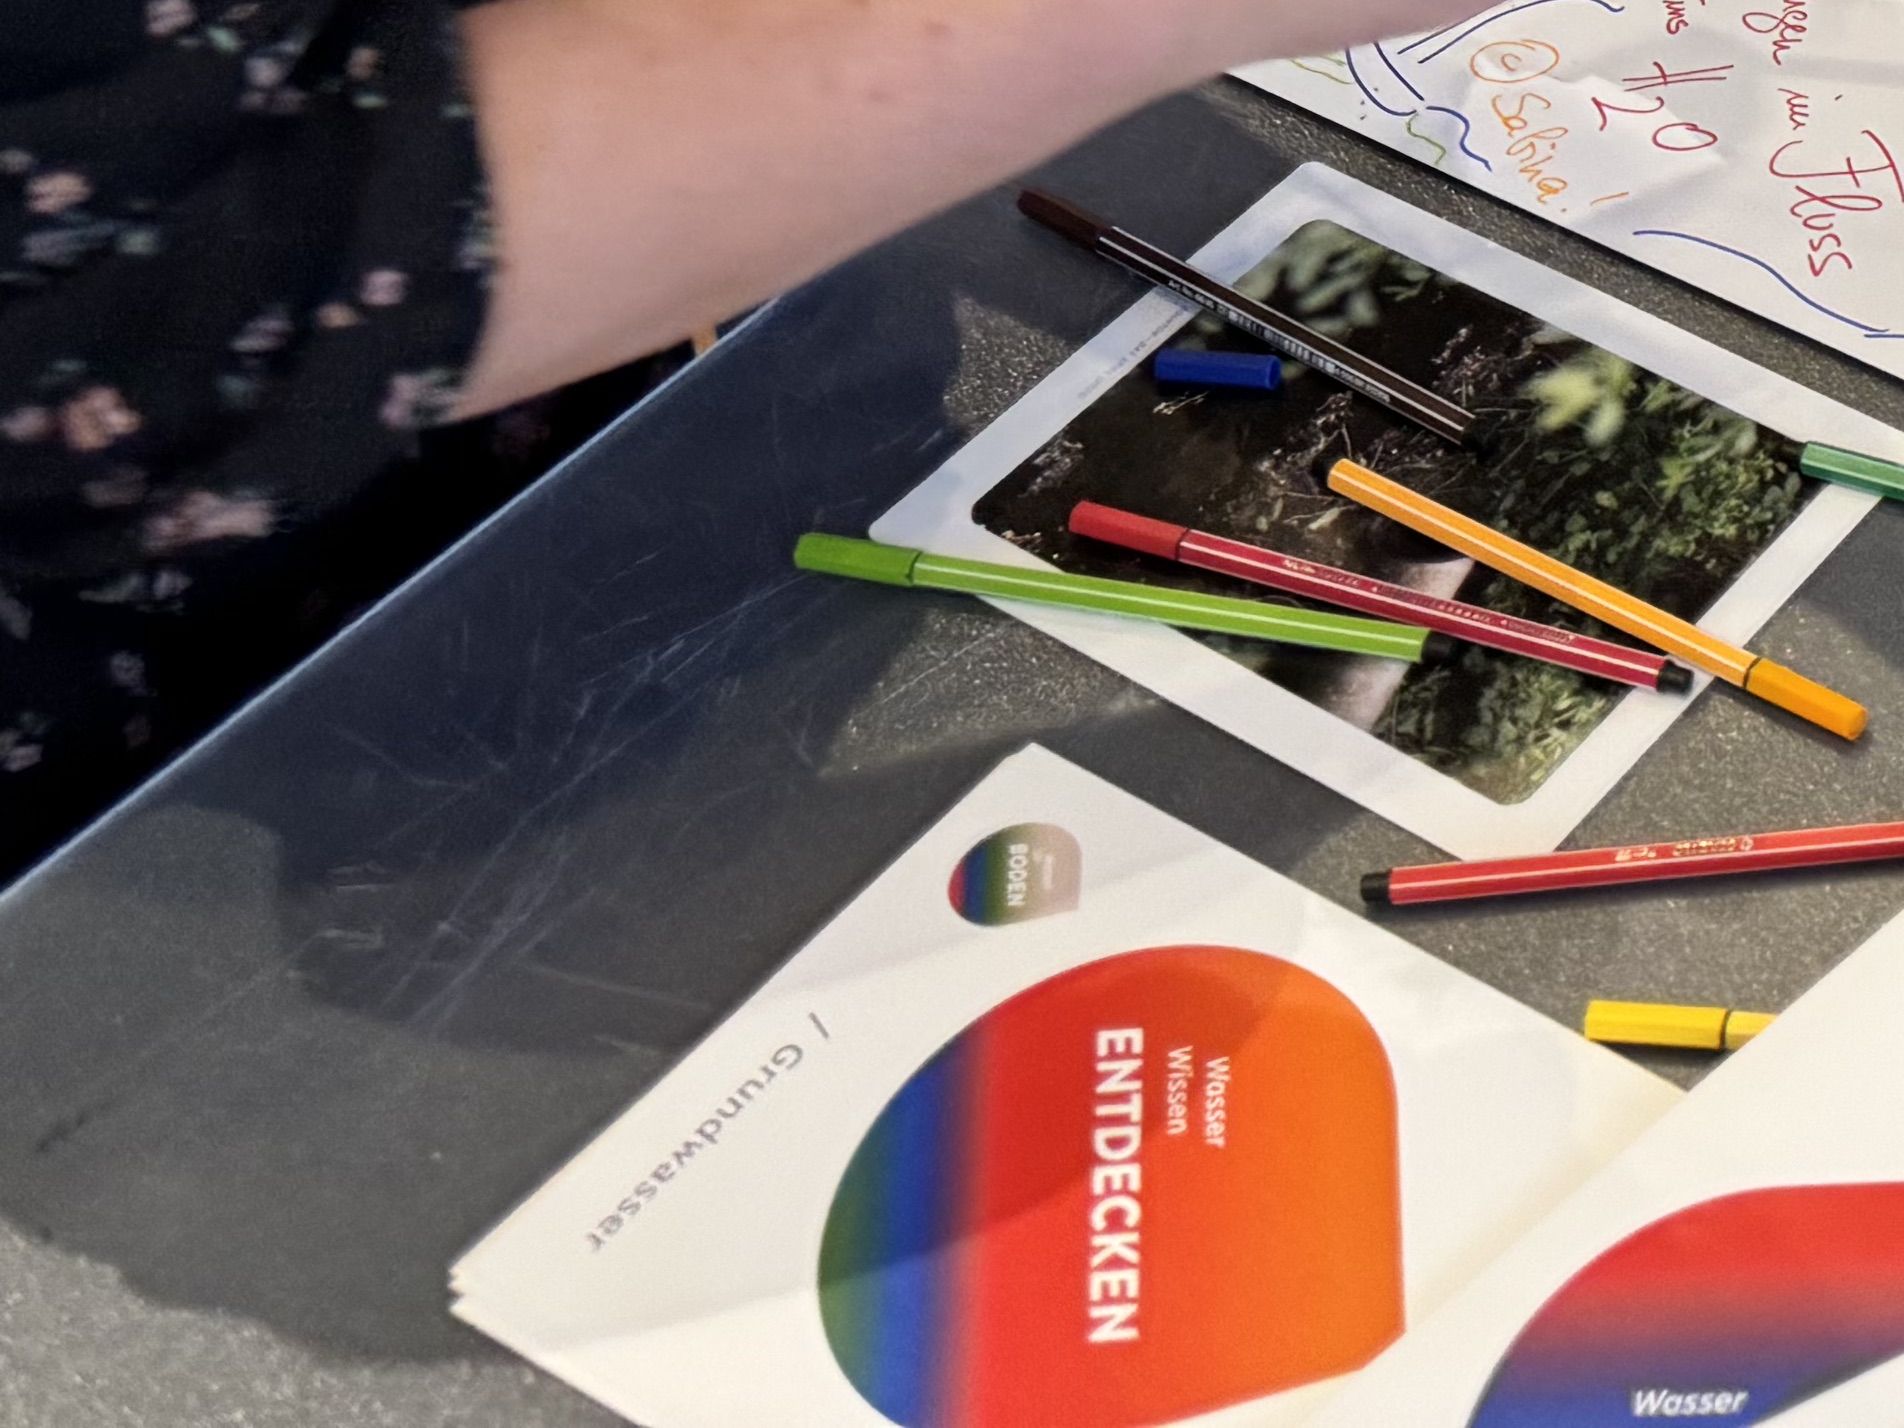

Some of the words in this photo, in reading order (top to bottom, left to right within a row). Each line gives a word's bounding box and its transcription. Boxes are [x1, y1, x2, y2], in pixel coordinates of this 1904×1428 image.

[1006, 843, 1029, 908] BODEN
[1166, 1045, 1194, 1136] Wissen
[1205, 1055, 1230, 1149] Wasser
[585, 1042, 805, 1254] Grundwasser
[1086, 1026, 1145, 1344] ENTDECKEN
[1633, 1388, 1749, 1417] Wasser
